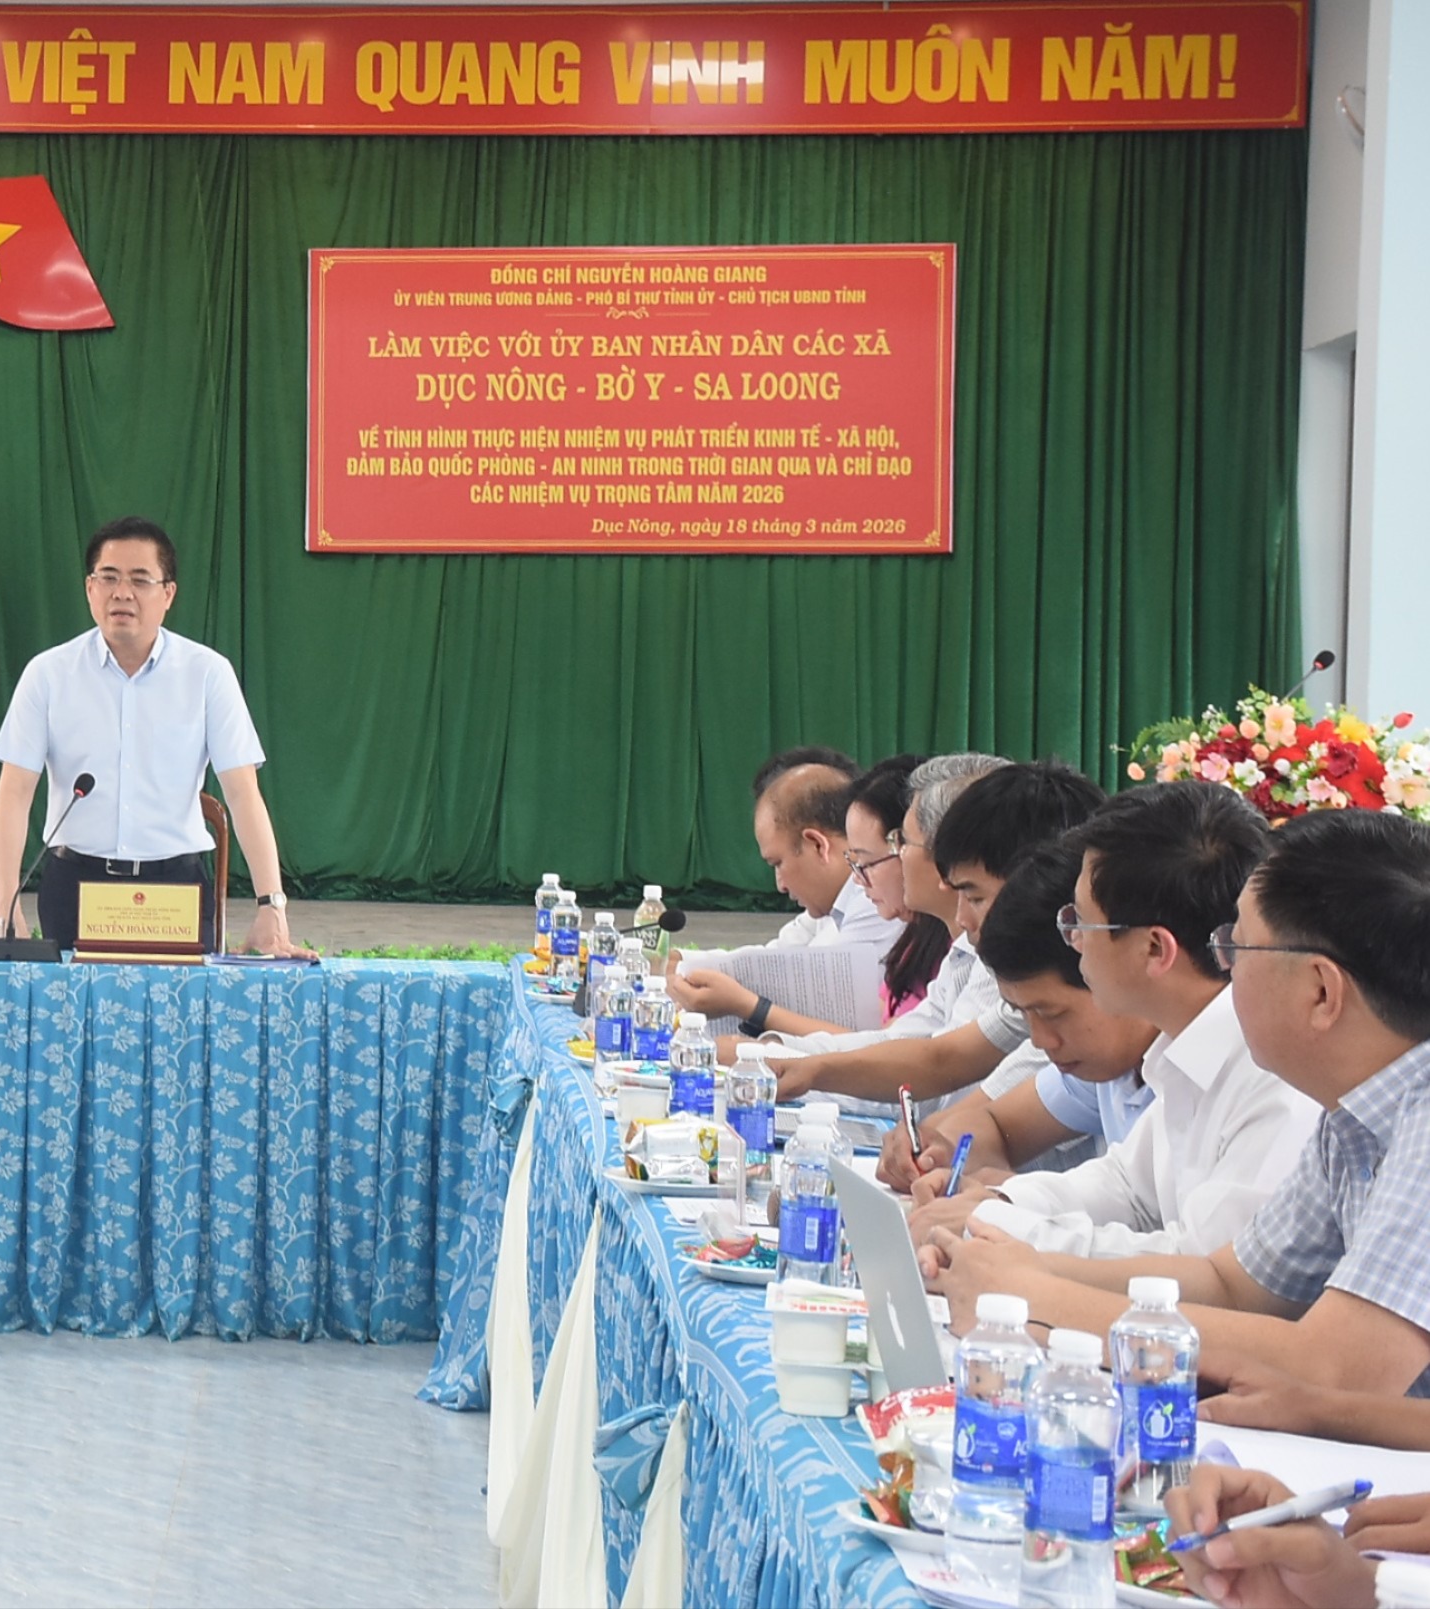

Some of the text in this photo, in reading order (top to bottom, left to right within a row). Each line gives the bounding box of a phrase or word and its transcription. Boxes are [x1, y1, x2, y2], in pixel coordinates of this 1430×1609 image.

[2, 27, 136, 115] VIỆT
[169, 41, 325, 104] NAM
[355, 40, 580, 112] QUANG
[609, 40, 764, 104] VINH
[804, 23, 1011, 103] MUÔN
[1041, 21, 1238, 100] NĂM!
[490, 262, 767, 284] ĐỒNG CHÍ NGUYỄN HOÀNG GIANG
[394, 289, 411, 306] ỦY
[415, 290, 445, 306] VIÊN
[448, 293, 492, 306] TRUNG
[496, 292, 533, 306] ƯƠNG
[536, 288, 573, 306] ĐẢNG
[586, 290, 613, 305] PHÓ
[617, 290, 630, 305] BÍ
[635, 290, 661, 305] THƯ
[663, 288, 694, 305] TỈNH
[698, 287, 715, 305] ỦY
[729, 287, 756, 304] CHỦ
[759, 290, 787, 307] TỊCH
[793, 290, 831, 304] UBND
[834, 285, 866, 304] TỈNH
[368, 328, 891, 363] LÀM VIỆC VỚI ỦY BAN NHÂN DÂN CÁC XÃ
[416, 373, 476, 409] DỤC
[486, 366, 567, 401] NÔNG
[595, 365, 636, 401] BỜ
[644, 373, 665, 400] Y
[694, 372, 733, 401] SA
[741, 372, 841, 401] LOONG
[359, 424, 380, 448] VỀ
[384, 426, 422, 448] TÌNH
[427, 426, 467, 448] HÌNH
[472, 428, 515, 452] THỰC
[520, 426, 559, 452] HIỆN
[564, 426, 620, 452] NHIỆM
[625, 429, 647, 452] VỤ
[651, 425, 696, 448] PHÁT
[700, 422, 749, 448] TRIỂN
[754, 429, 795, 448] KINH
[801, 423, 822, 448] TẾ
[837, 425, 860, 448] XÃ
[865, 425, 900, 452] HỘI,
[346, 452, 384, 476] ĐẢM
[390, 452, 423, 476] BẢO
[428, 451, 473, 478] QUỐC
[478, 454, 535, 476] PHÒNG
[552, 457, 576, 476] AN
[581, 457, 622, 476] NINH
[628, 457, 683, 475] TRONG
[688, 453, 726, 475] THỜI
[731, 457, 772, 475] GIAN
[777, 457, 811, 478] QUA
[816, 454, 838, 475] VÀ
[842, 451, 871, 475] CHỈ
[876, 457, 912, 480] ĐẠO
[470, 481, 784, 508] CÁC NHIỆM VỤ TRỌNG TÂM NĂM 2026
[591, 518, 906, 537] Dục Nông, ngày 18 tháng 3 năm 2026
